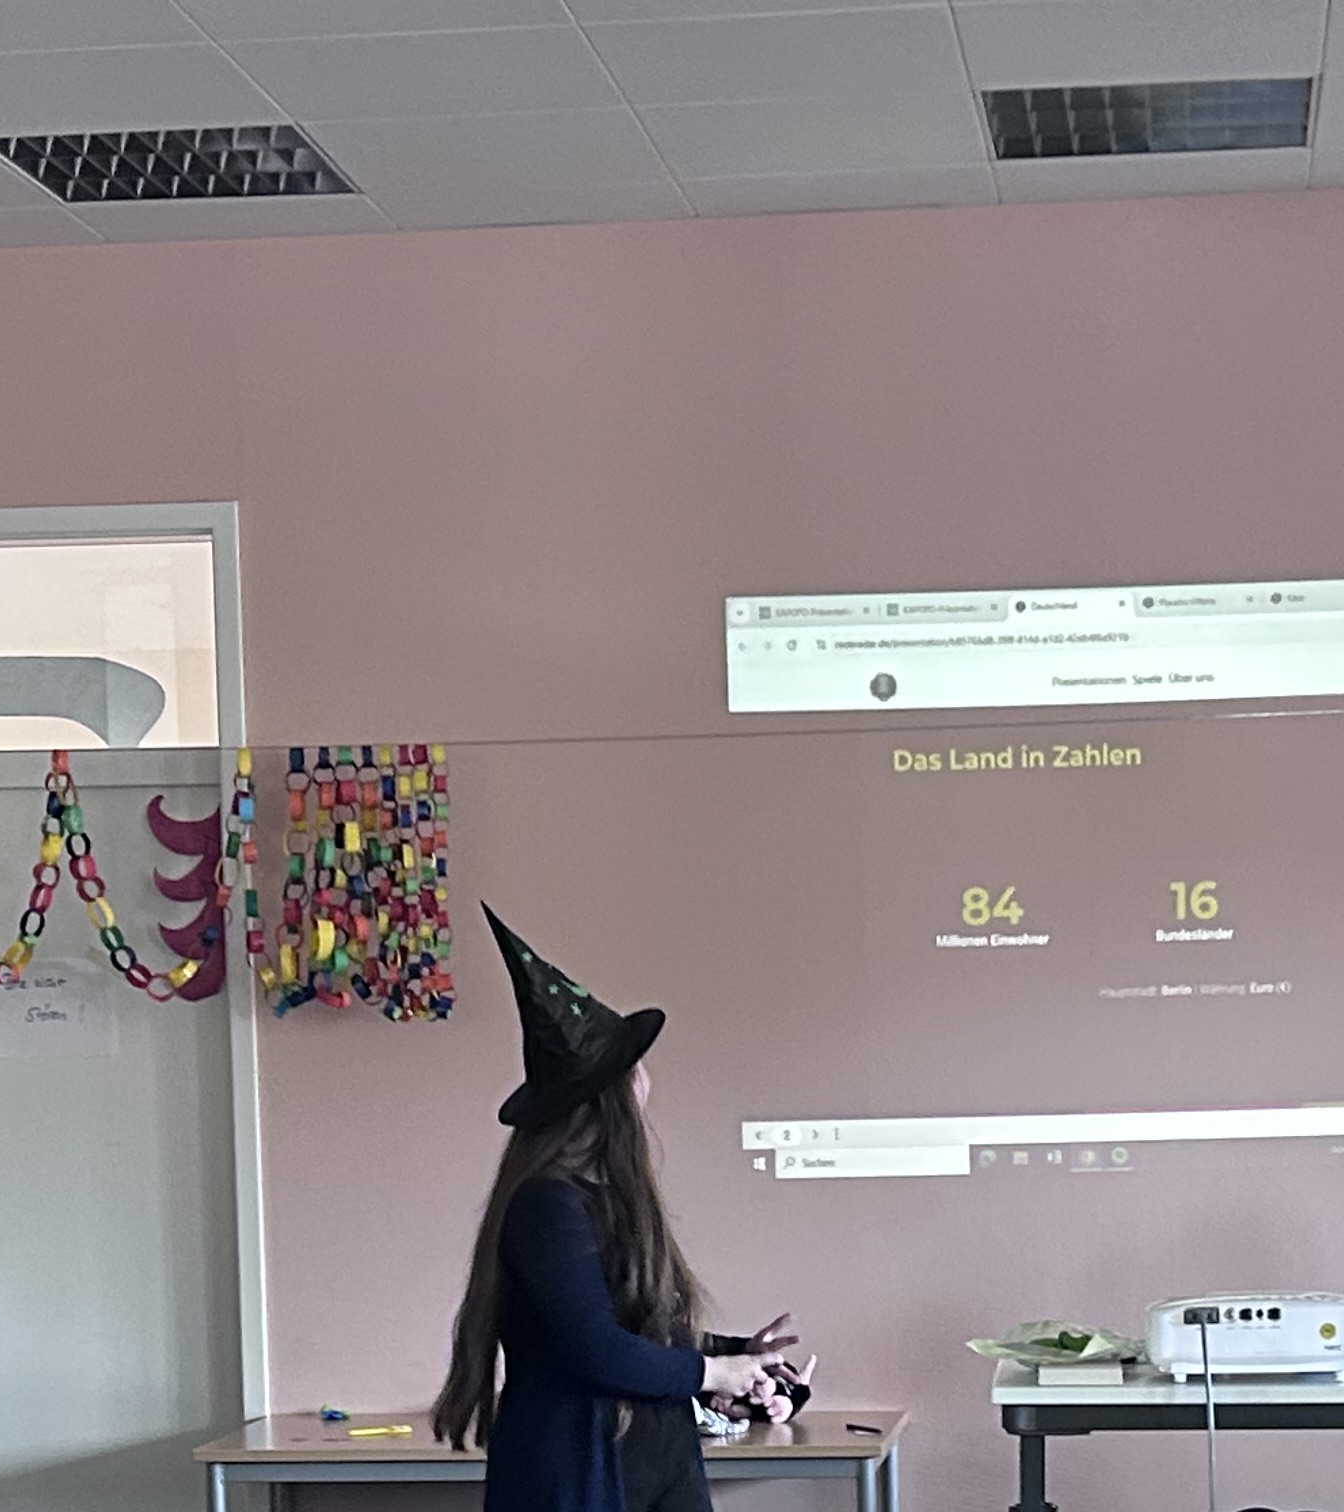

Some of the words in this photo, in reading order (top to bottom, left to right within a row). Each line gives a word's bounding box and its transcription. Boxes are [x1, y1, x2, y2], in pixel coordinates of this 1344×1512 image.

[892, 749, 942, 772] Das
[949, 746, 1014, 771] Land
[1021, 744, 1045, 769] in
[1052, 742, 1142, 768] Zahlen
[961, 886, 1024, 926] 84
[1169, 880, 1219, 920] 16
